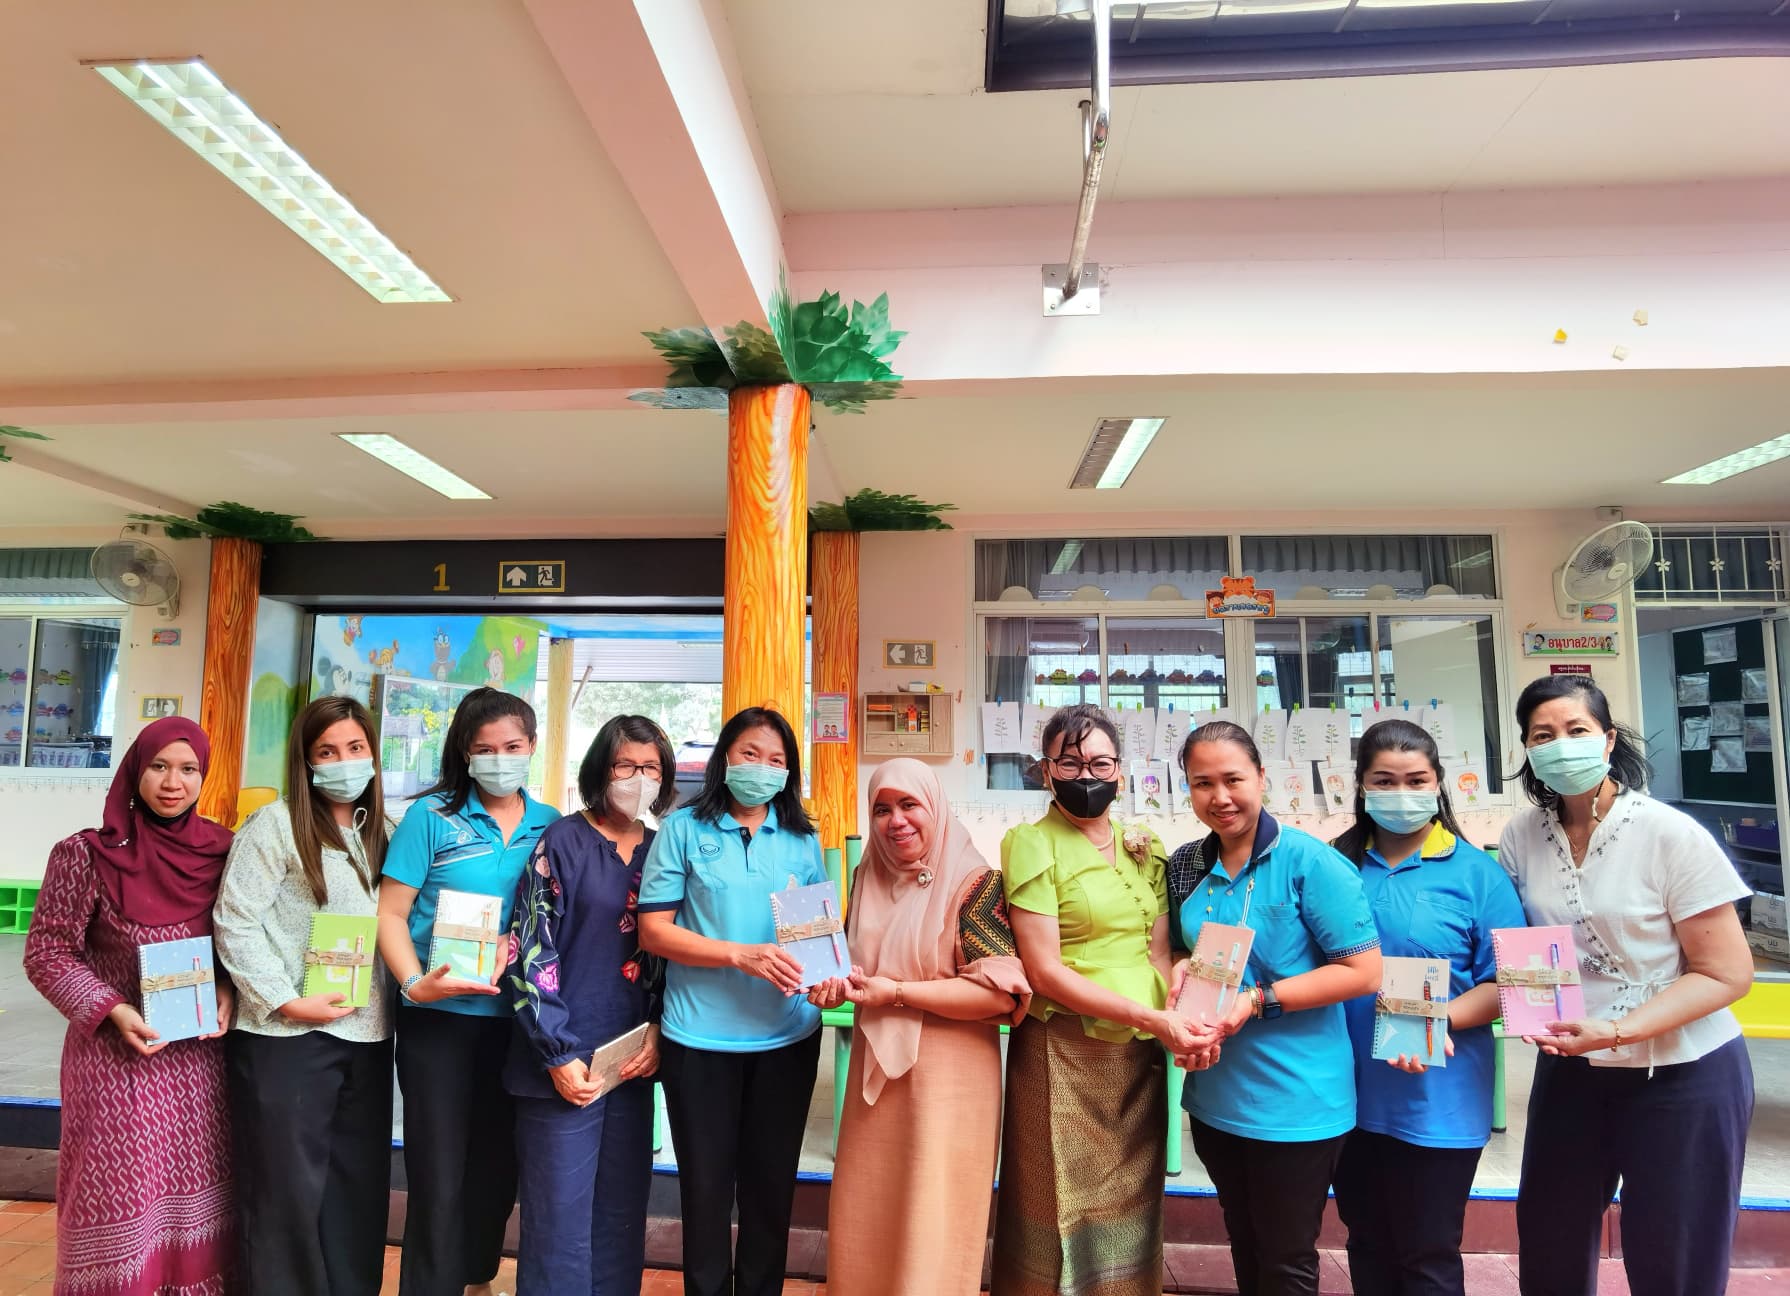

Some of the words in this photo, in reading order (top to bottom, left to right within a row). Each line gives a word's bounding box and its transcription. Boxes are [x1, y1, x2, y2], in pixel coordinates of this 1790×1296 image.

[433, 563, 450, 591] 1
[1548, 636, 1597, 652] อนุบาล2/3
